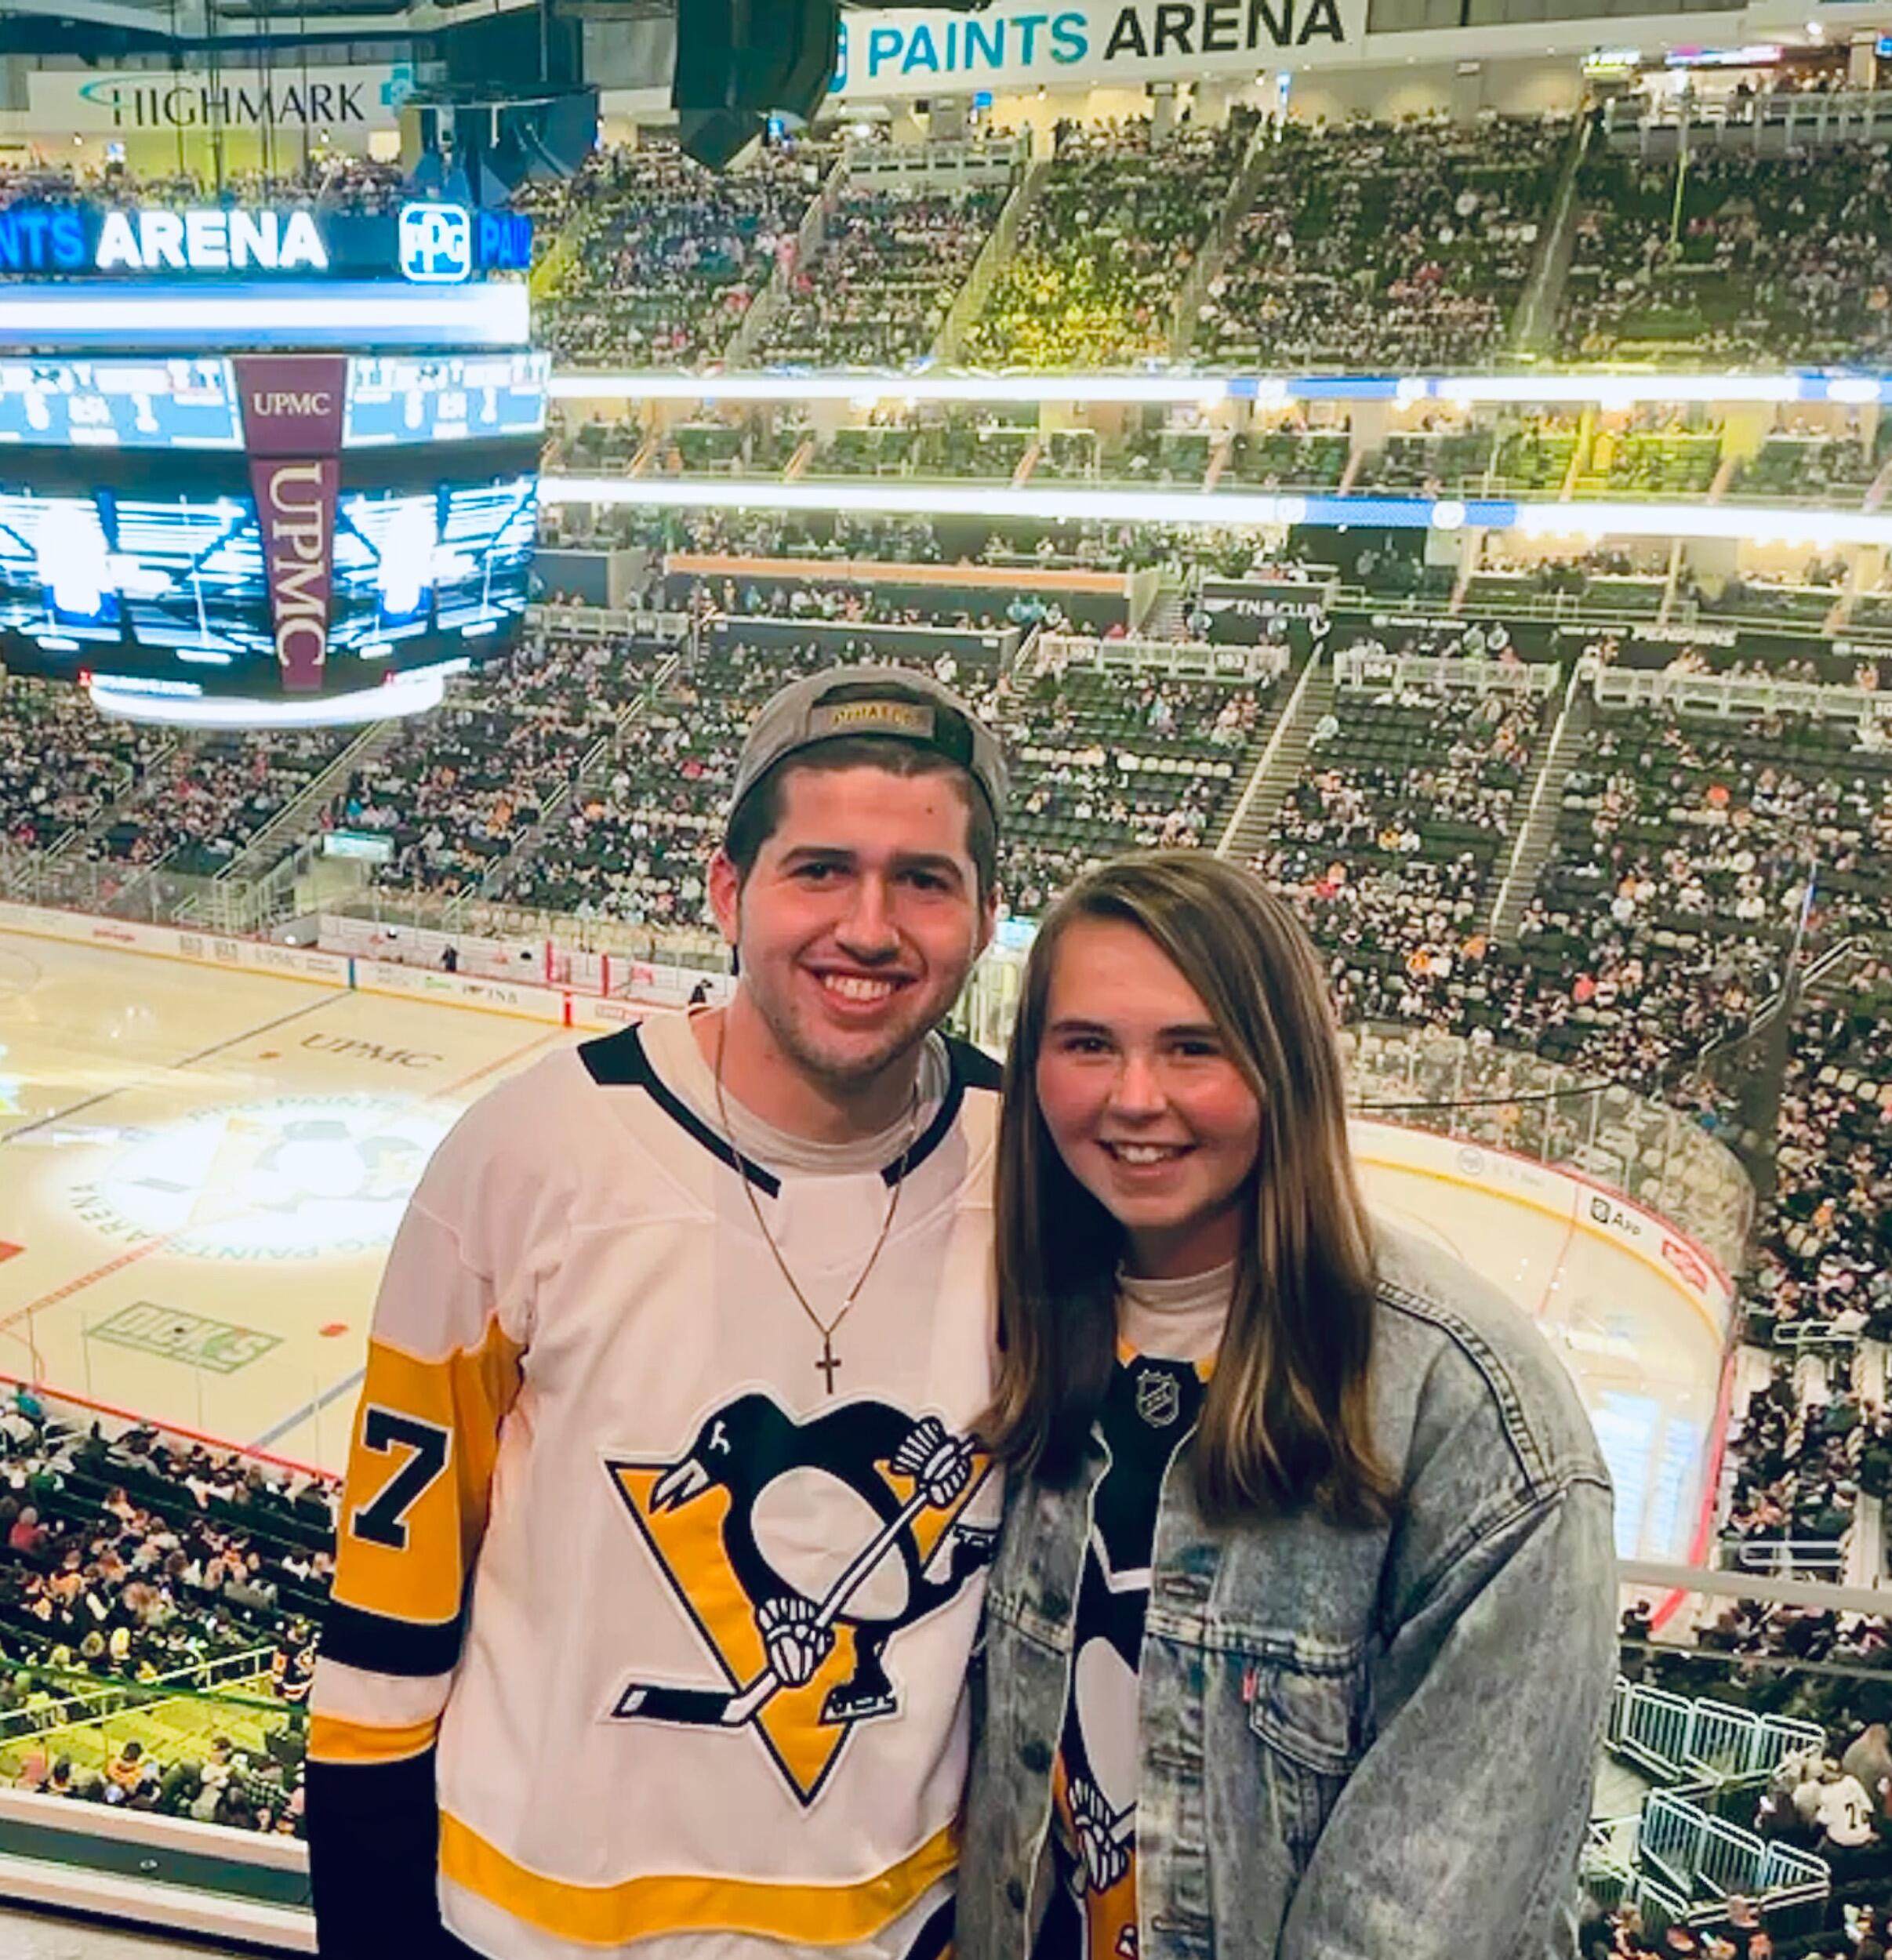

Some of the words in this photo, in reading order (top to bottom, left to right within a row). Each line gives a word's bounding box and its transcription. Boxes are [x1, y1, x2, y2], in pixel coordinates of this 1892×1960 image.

[868, 12, 1088, 77] PAINTS
[1102, 0, 1345, 60] ARENA
[112, 81, 365, 127] HIGHMARK
[95, 209, 329, 270] ARENA
[401, 209, 469, 274] PPG
[253, 391, 331, 416] UPMC
[269, 461, 328, 666] UPMC
[300, 1033, 444, 1068] UPMC
[350, 1403, 453, 1551] 7
